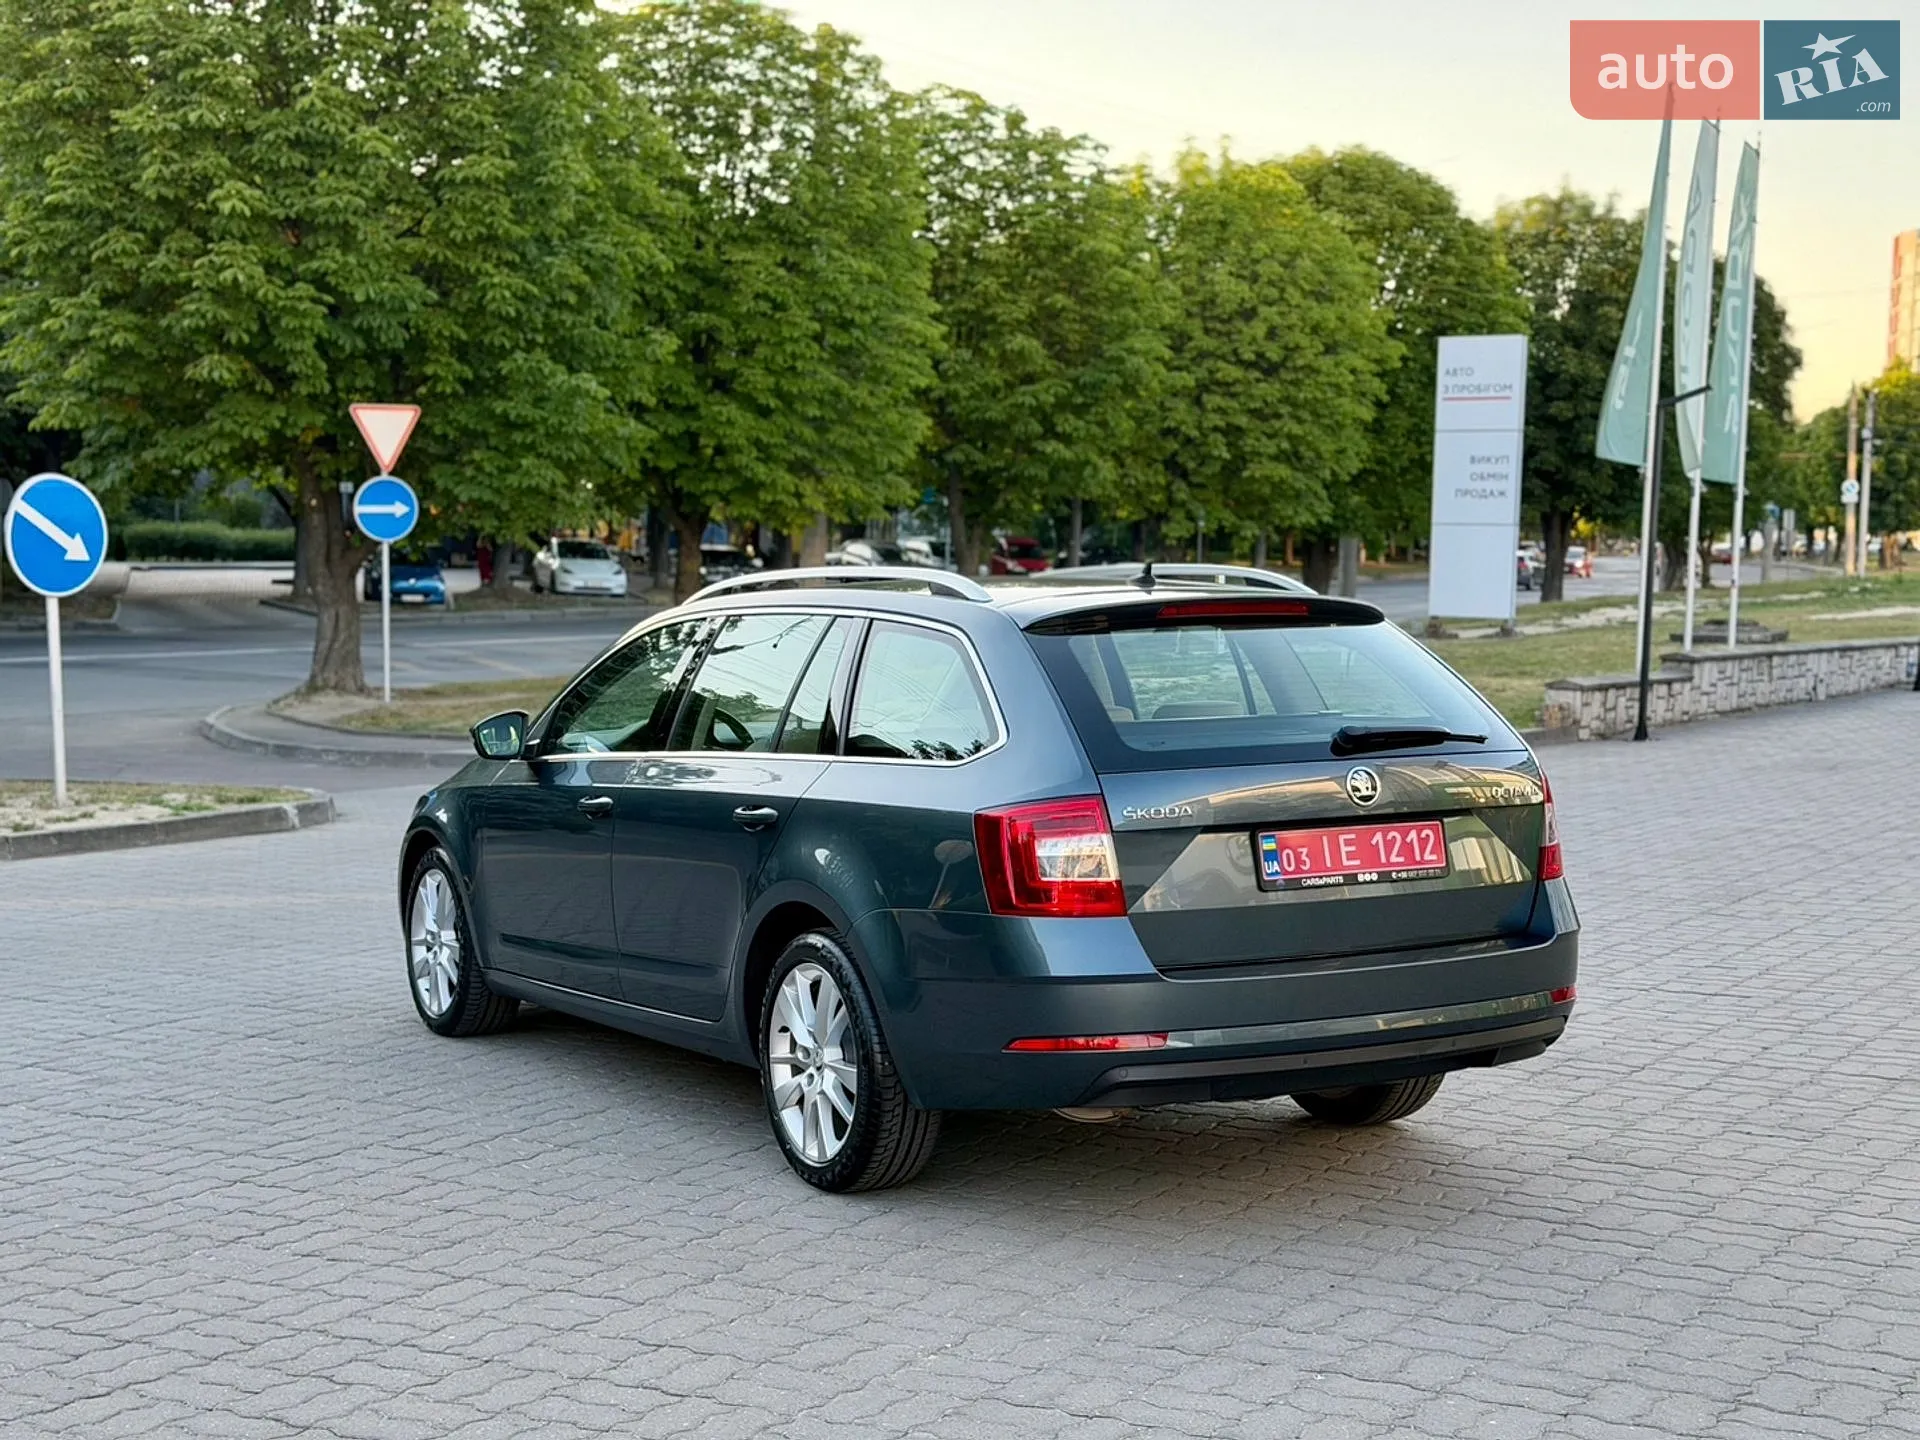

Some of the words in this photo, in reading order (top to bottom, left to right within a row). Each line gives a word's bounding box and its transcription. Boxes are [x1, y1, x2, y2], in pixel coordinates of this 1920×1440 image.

[1443, 366, 1475, 377] АВТО
[1452, 383, 1513, 394] ПРОБІГОМ
[1470, 455, 1510, 465] ВИКУП
[1470, 471, 1509, 482] ОБМІН
[1454, 488, 1508, 499] ПРОДАЖ
[1282, 847, 1311, 872] 03
[1322, 833, 1361, 868] IE
[1370, 829, 1438, 865] 1212
[1264, 860, 1281, 874] UA
